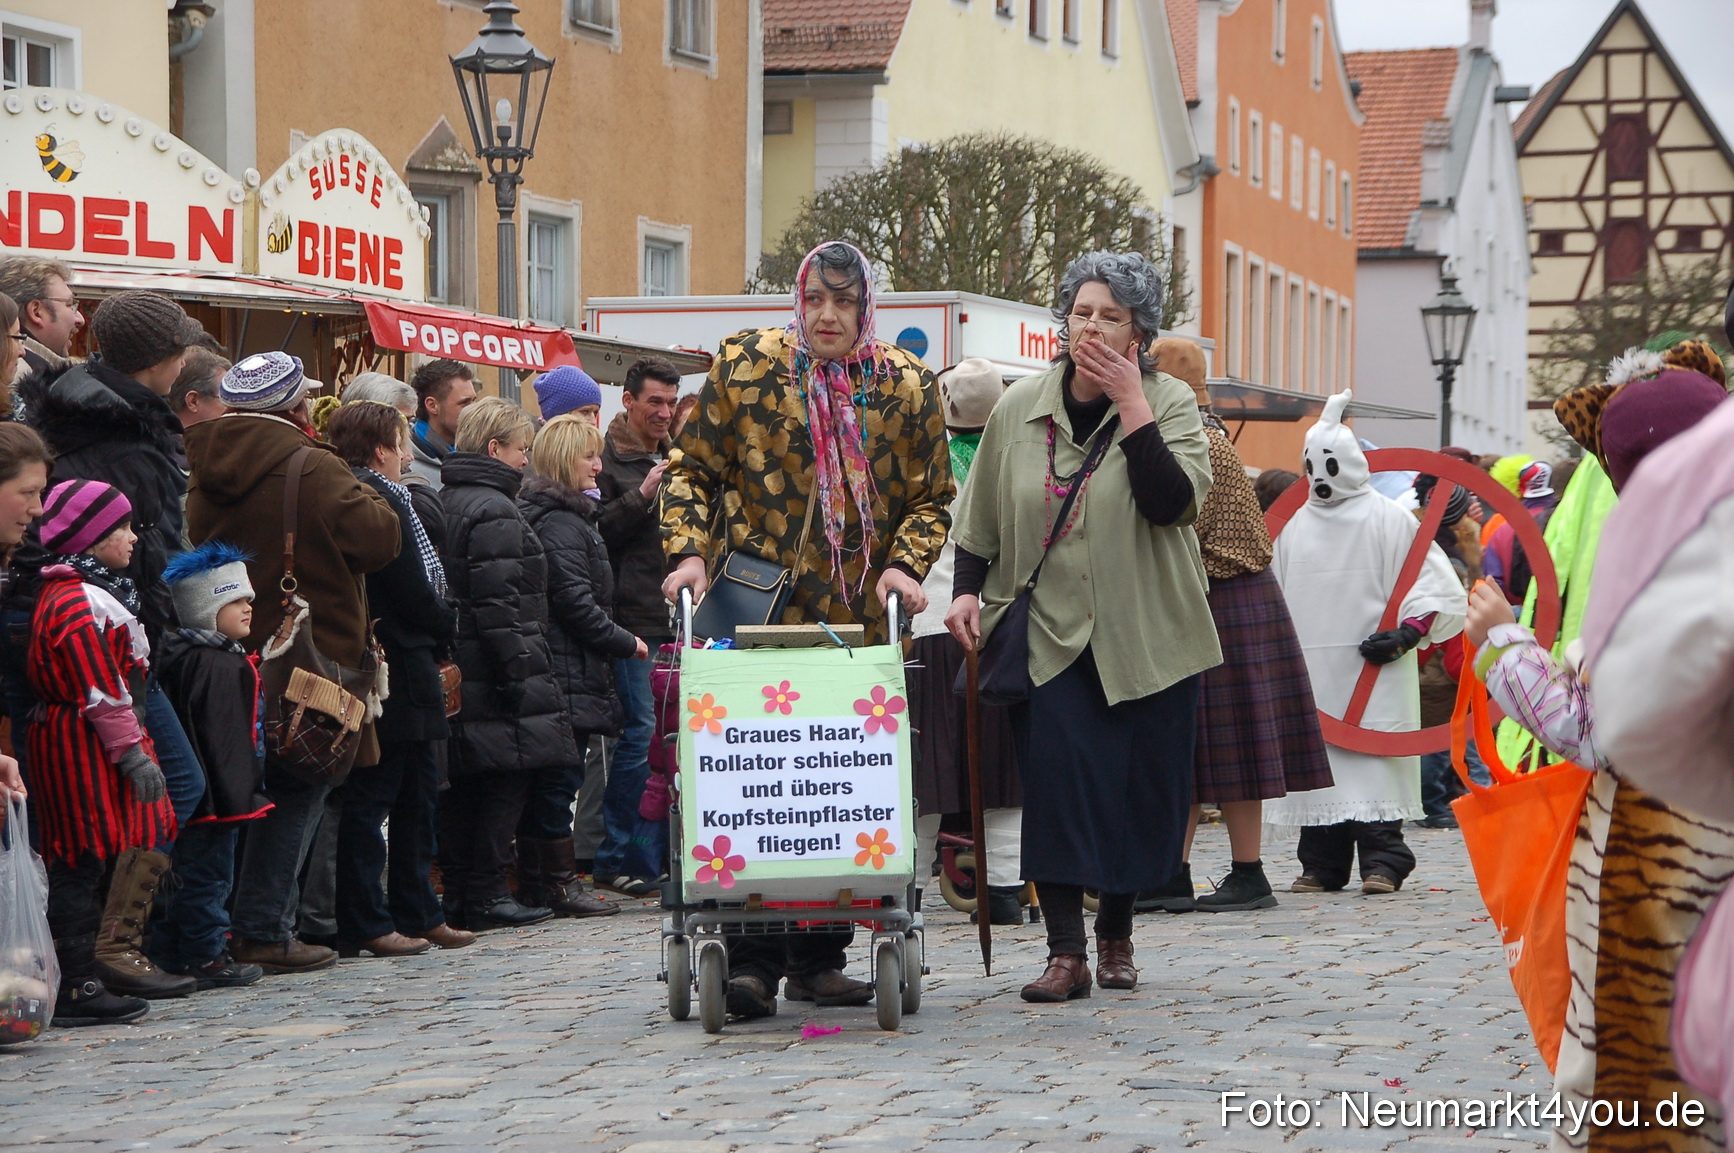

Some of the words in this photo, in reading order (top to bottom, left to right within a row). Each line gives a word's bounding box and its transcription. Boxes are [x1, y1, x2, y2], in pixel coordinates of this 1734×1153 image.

[298, 220, 404, 291] BIENE
[399, 320, 545, 366] POPCORN
[726, 728, 801, 744] Graues
[810, 725, 864, 743] Haar,
[700, 754, 786, 772] Rollator
[794, 751, 892, 769] schieben
[743, 781, 782, 798] und
[792, 780, 853, 796] übers
[704, 805, 894, 830] Kopfsteinpflaster
[758, 834, 840, 855] fliegen!
